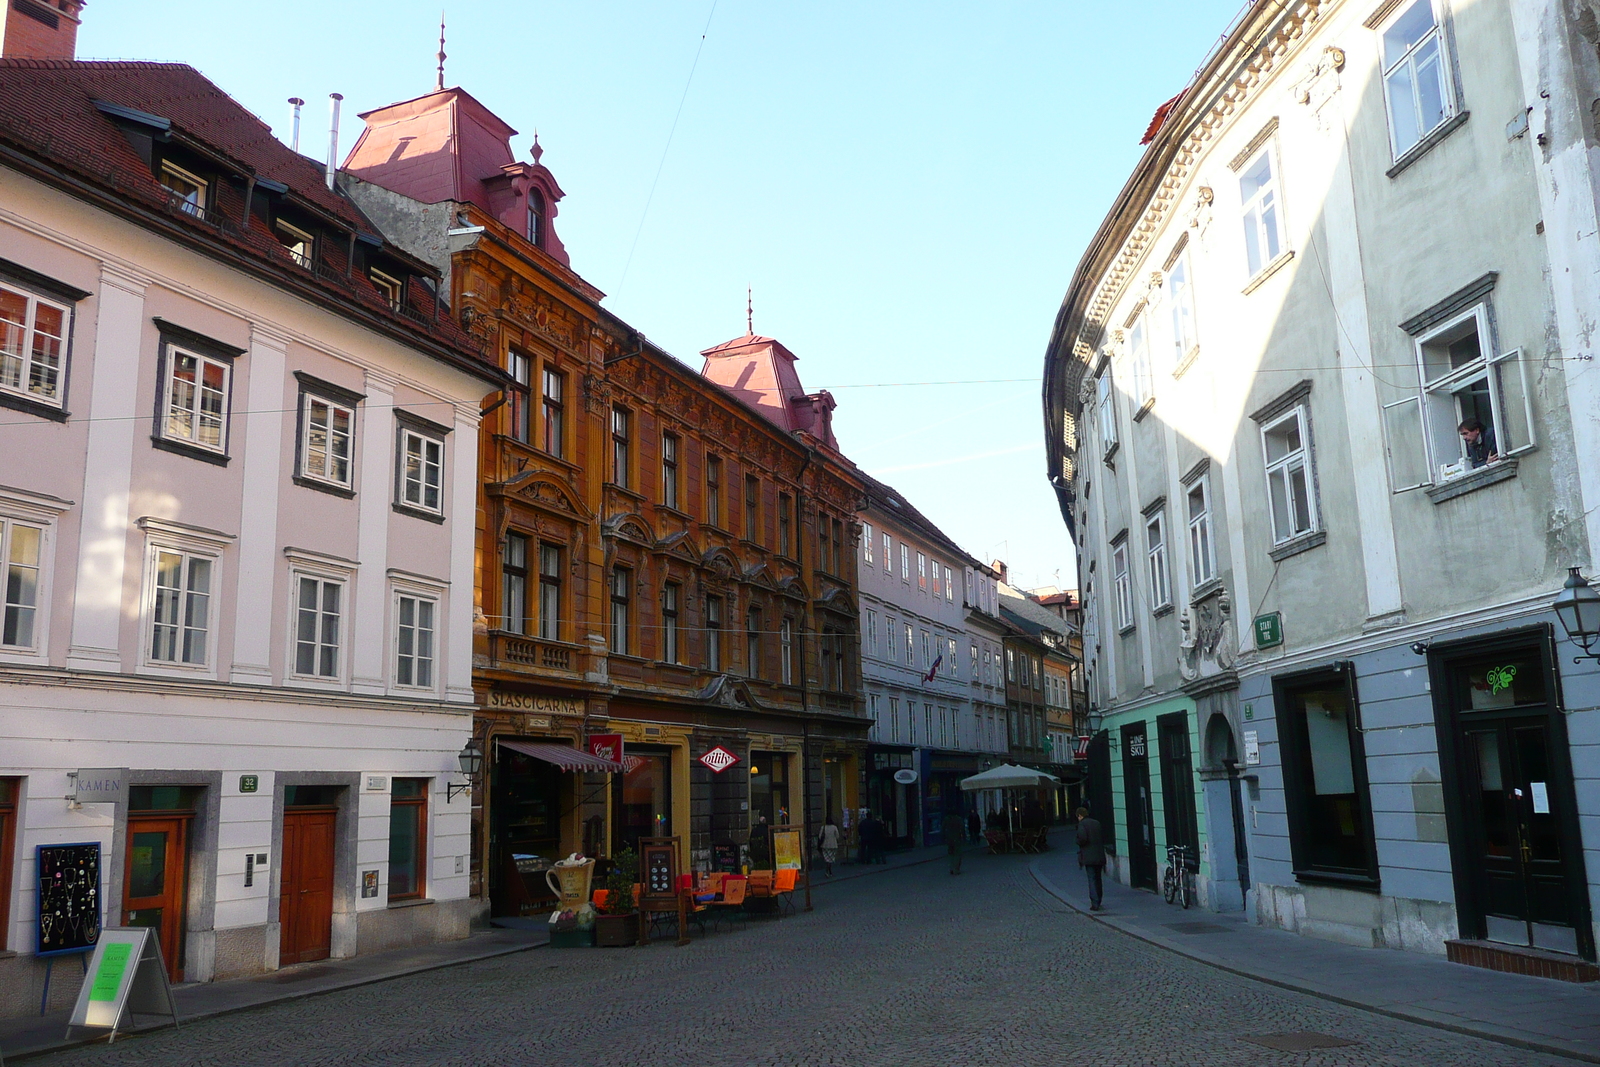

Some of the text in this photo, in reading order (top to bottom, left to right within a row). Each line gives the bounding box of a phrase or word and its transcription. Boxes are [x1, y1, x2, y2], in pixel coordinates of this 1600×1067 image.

[705, 752, 731, 768] oilily
[78, 779, 121, 791] KAMEN
[245, 778, 254, 786] 32
